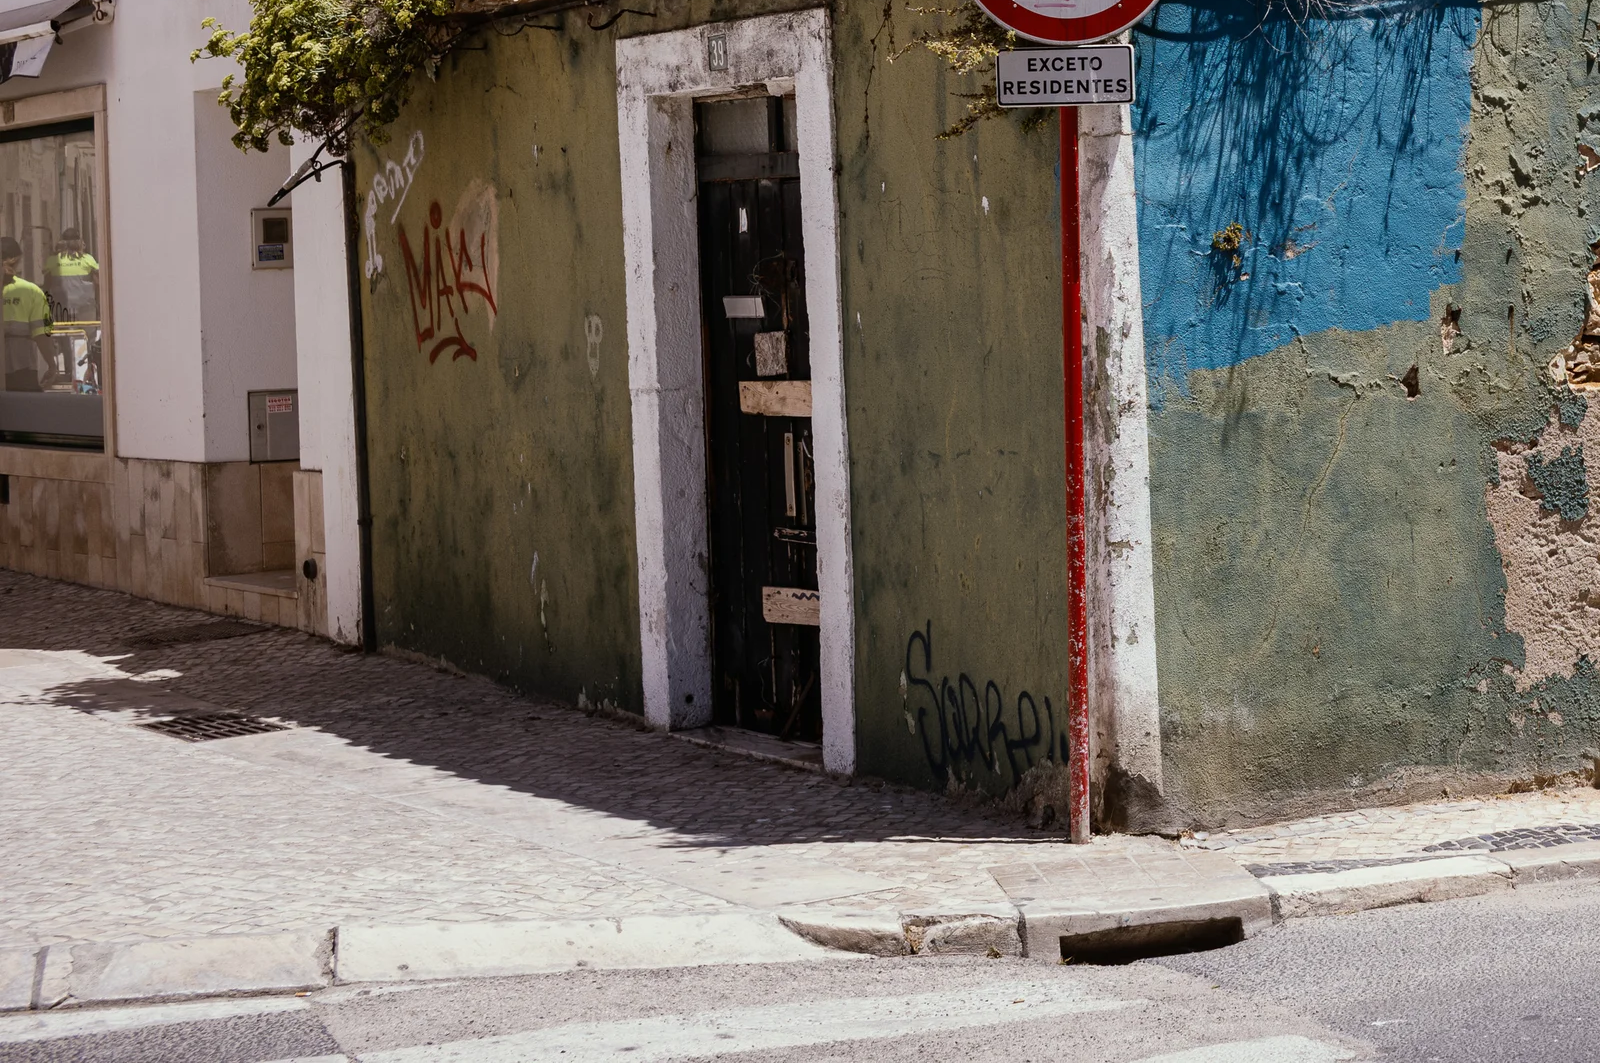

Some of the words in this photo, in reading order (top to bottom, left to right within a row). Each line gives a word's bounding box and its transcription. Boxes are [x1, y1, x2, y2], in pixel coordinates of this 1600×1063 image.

[711, 40, 724, 66] 39
[1027, 56, 1103, 72] EXCETO
[1003, 78, 1128, 95] RESIDENTES
